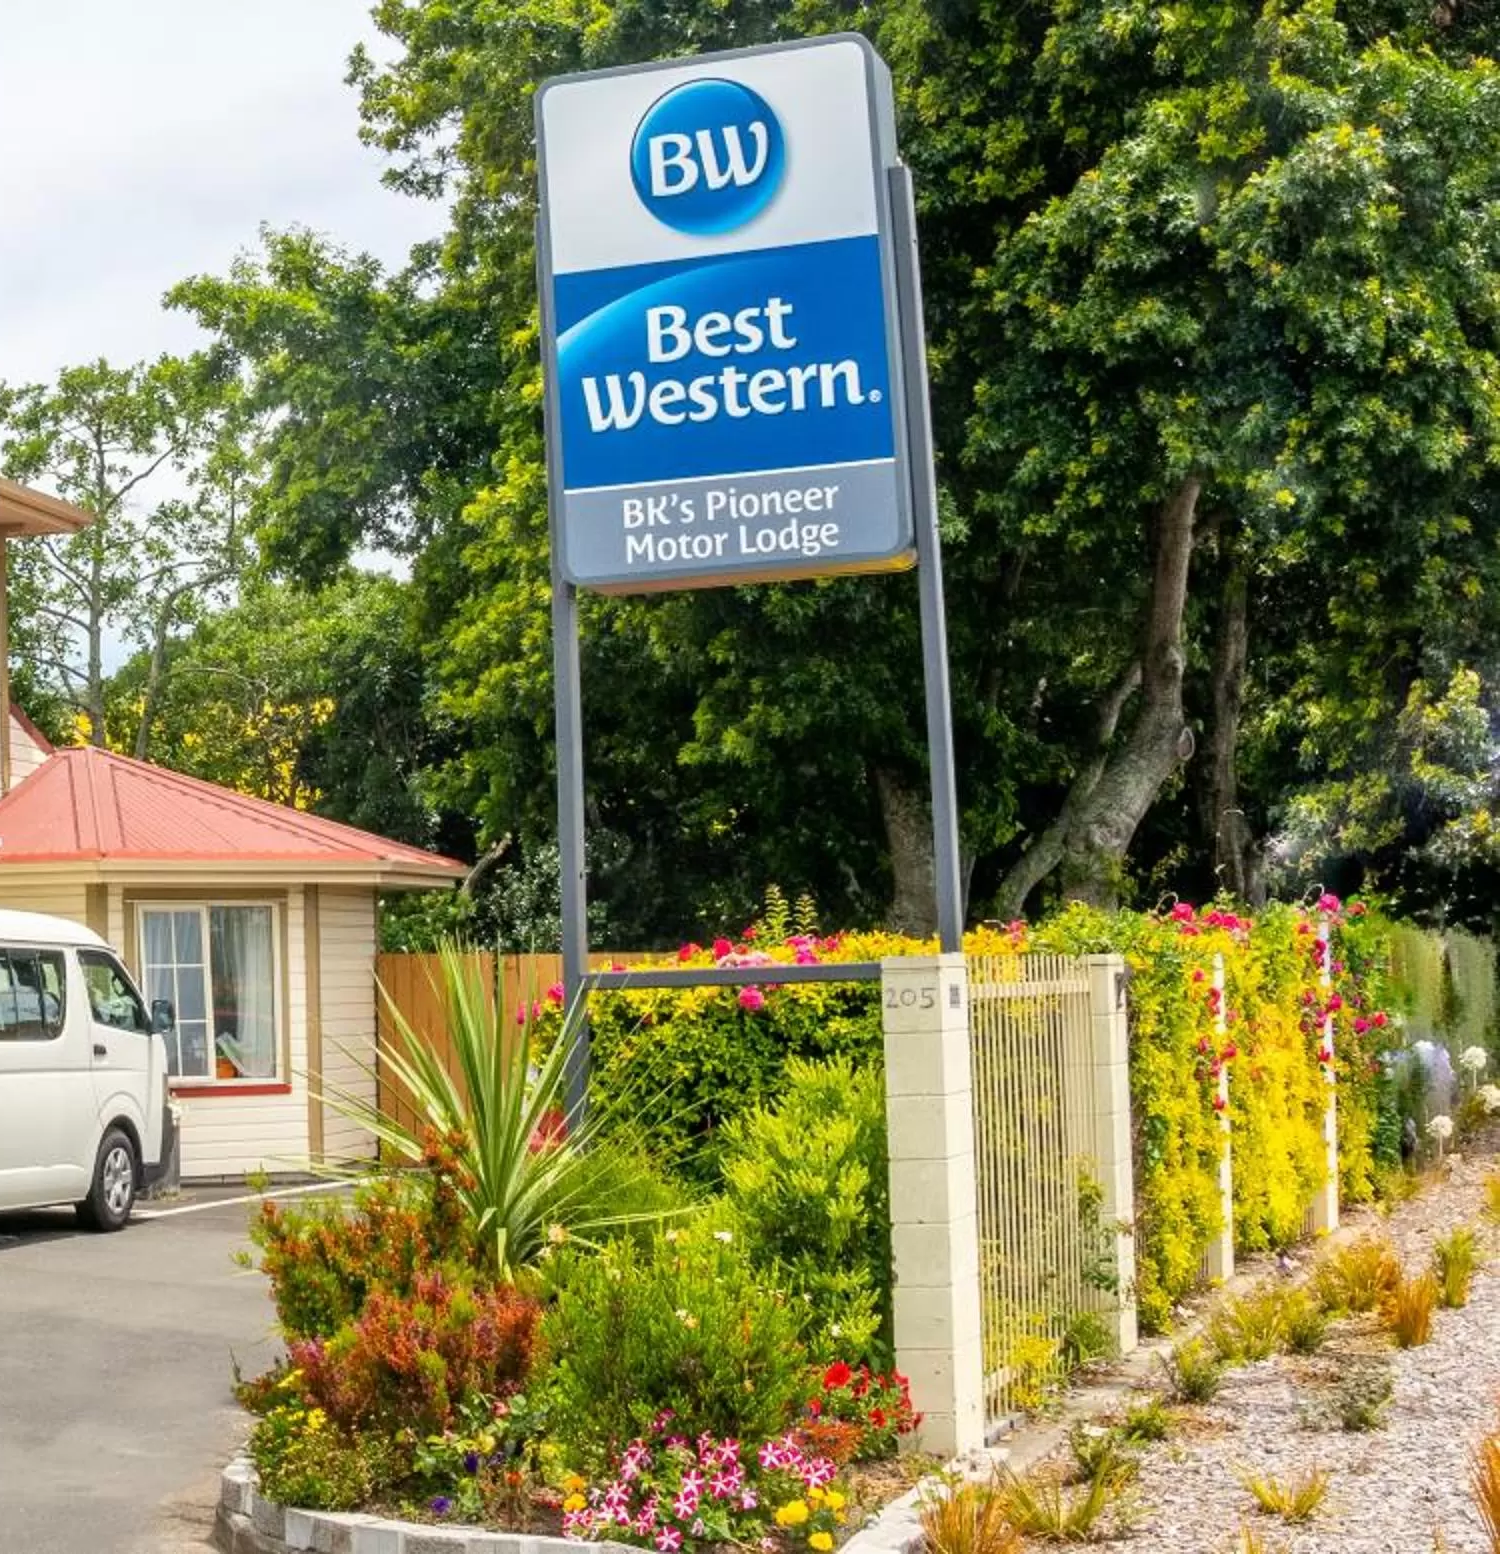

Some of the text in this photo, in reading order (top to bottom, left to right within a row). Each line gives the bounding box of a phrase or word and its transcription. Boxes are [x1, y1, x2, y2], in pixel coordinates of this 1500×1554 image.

[649, 121, 768, 197] BW
[647, 297, 797, 363] Best
[706, 485, 839, 521] Pioneer
[625, 517, 839, 564] Motor Lodge
[886, 987, 936, 1009] 205
